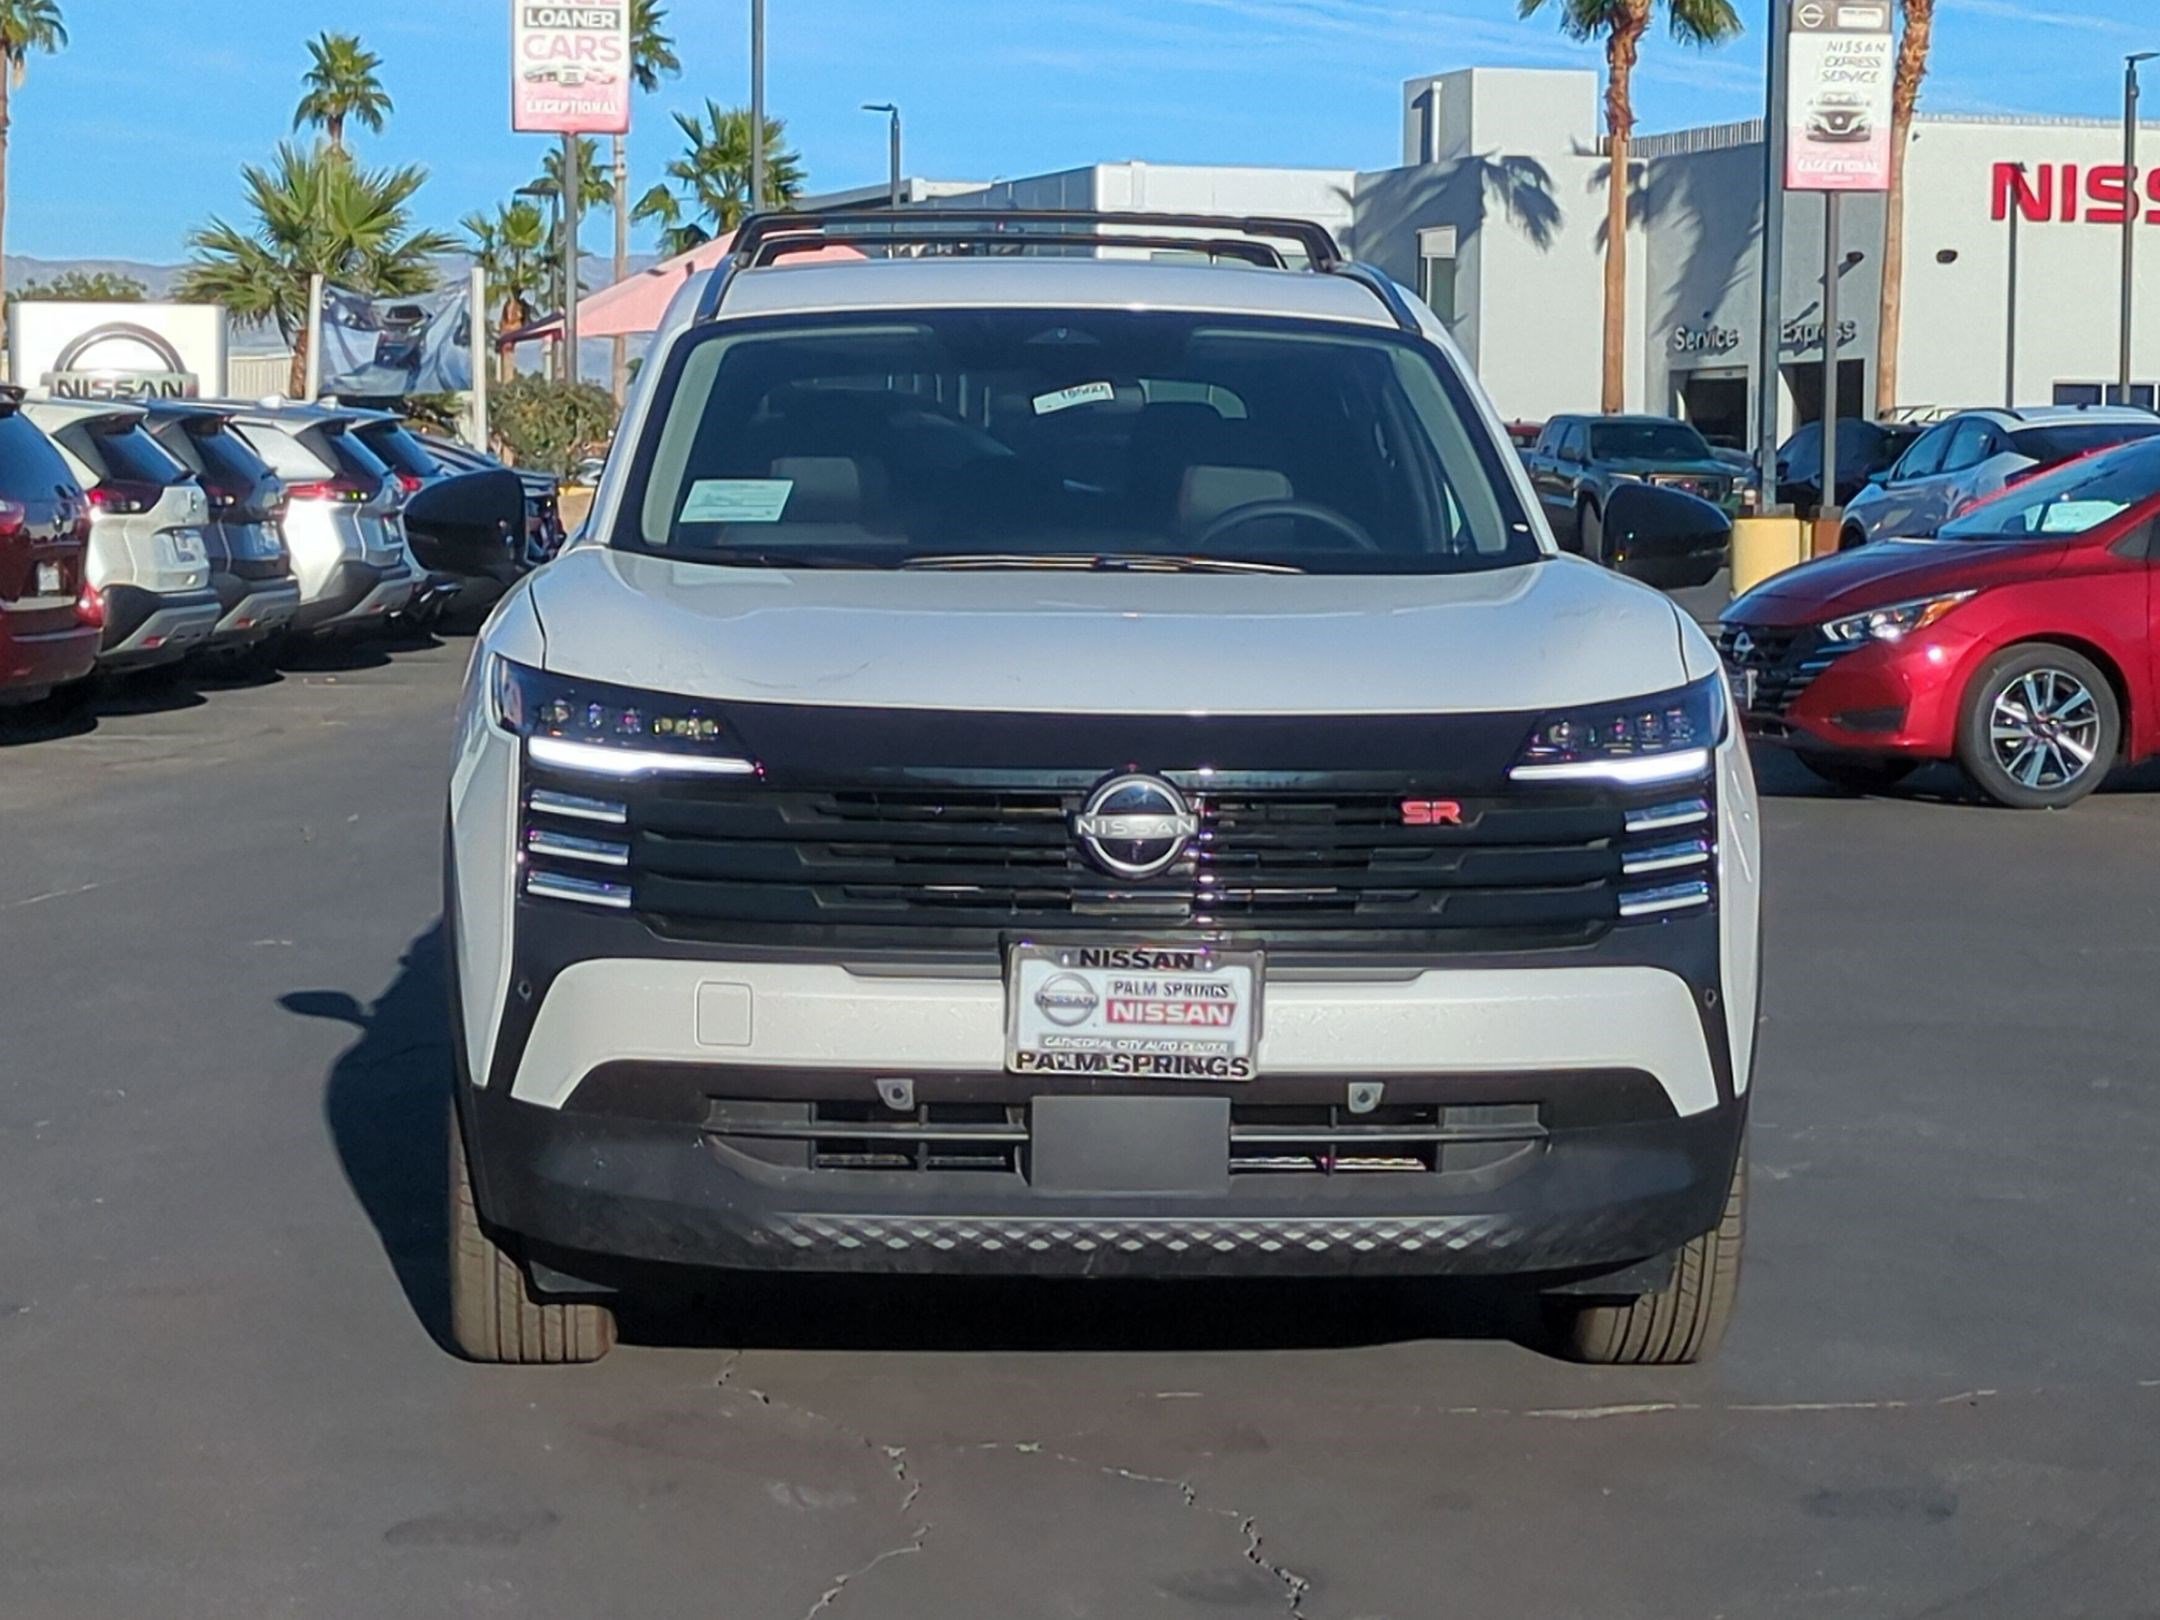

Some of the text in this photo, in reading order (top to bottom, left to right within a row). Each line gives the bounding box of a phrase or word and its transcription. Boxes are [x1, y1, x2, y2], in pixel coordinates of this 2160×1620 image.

[526, 8, 617, 29] LOANER
[523, 34, 622, 62] CARS
[1826, 40, 1886, 53] NISSAN
[1821, 70, 1879, 83] SERVICE
[1991, 162, 2160, 225] NIS
[1674, 325, 1739, 350] Service
[56, 378, 183, 399] NISSAN
[1402, 800, 1462, 824] SR
[1077, 818, 1195, 835] NISSAN
[1079, 949, 1195, 970] NISSAN
[1114, 980, 1229, 999] PALM SPRINGS
[1112, 1003, 1230, 1025] NISSAN
[1116, 1039, 1145, 1051] CITY
[1144, 1041, 1178, 1052] AUTO
[1016, 1052, 1249, 1077] PALM SPRINGS
